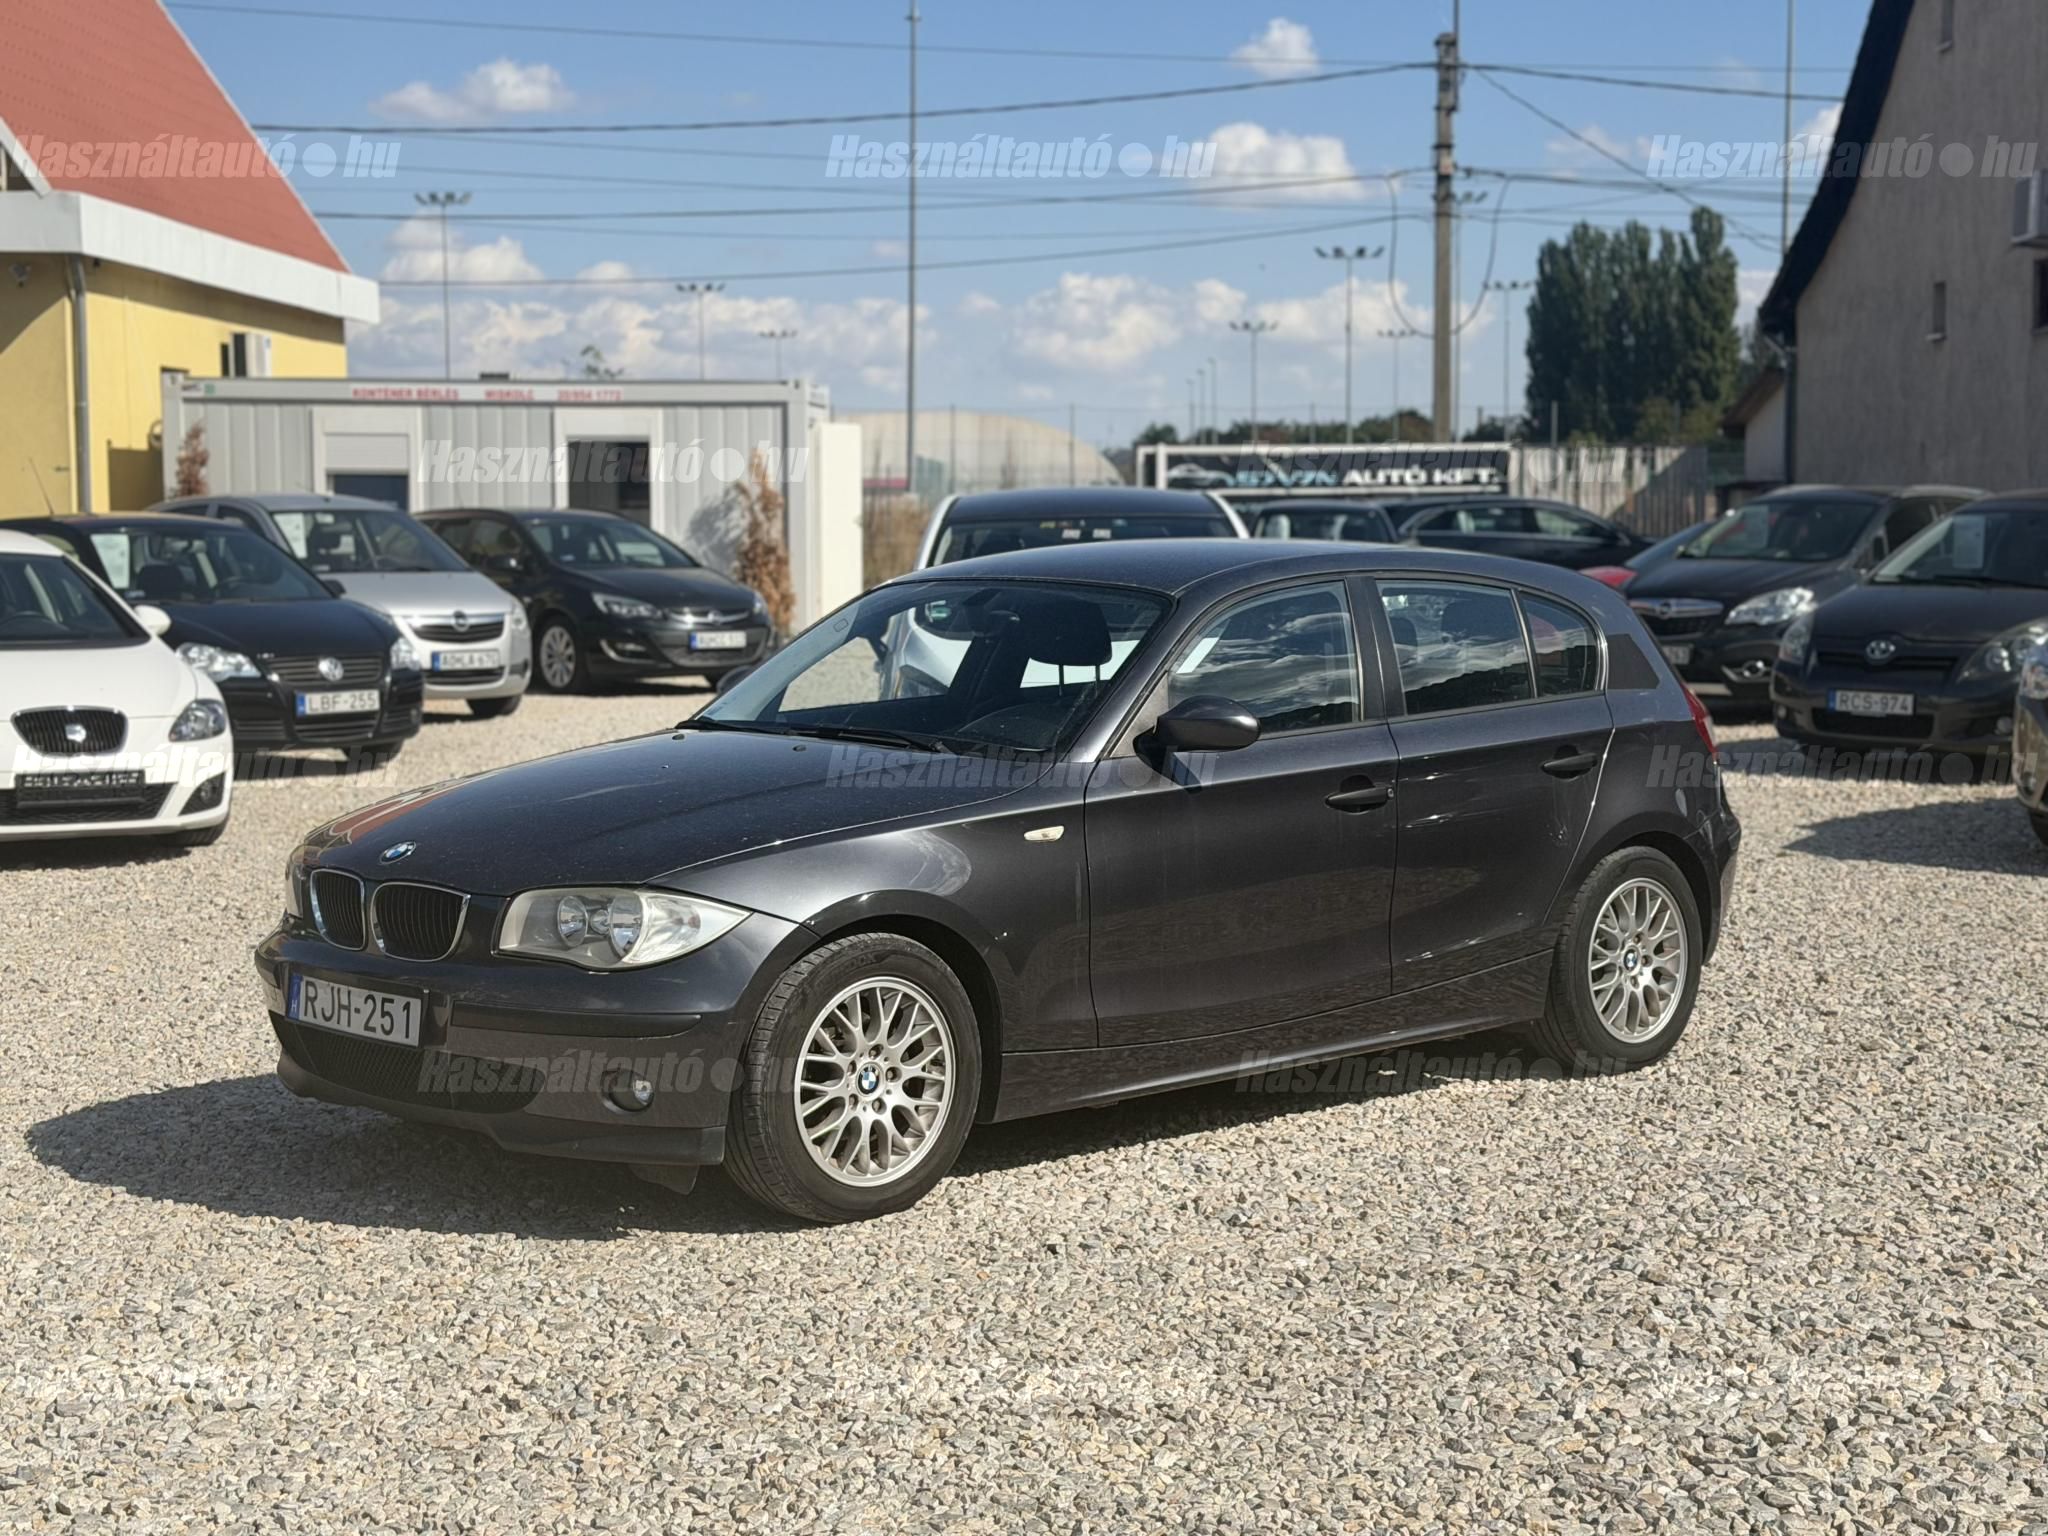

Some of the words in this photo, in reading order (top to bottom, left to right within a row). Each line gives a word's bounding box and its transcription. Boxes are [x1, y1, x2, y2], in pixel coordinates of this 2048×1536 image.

[1342, 463, 1429, 484] AUTÓ
[308, 692, 377, 713] LBF-255
[1839, 694, 1910, 712] RCS-974
[304, 980, 412, 1040] RJH-251
